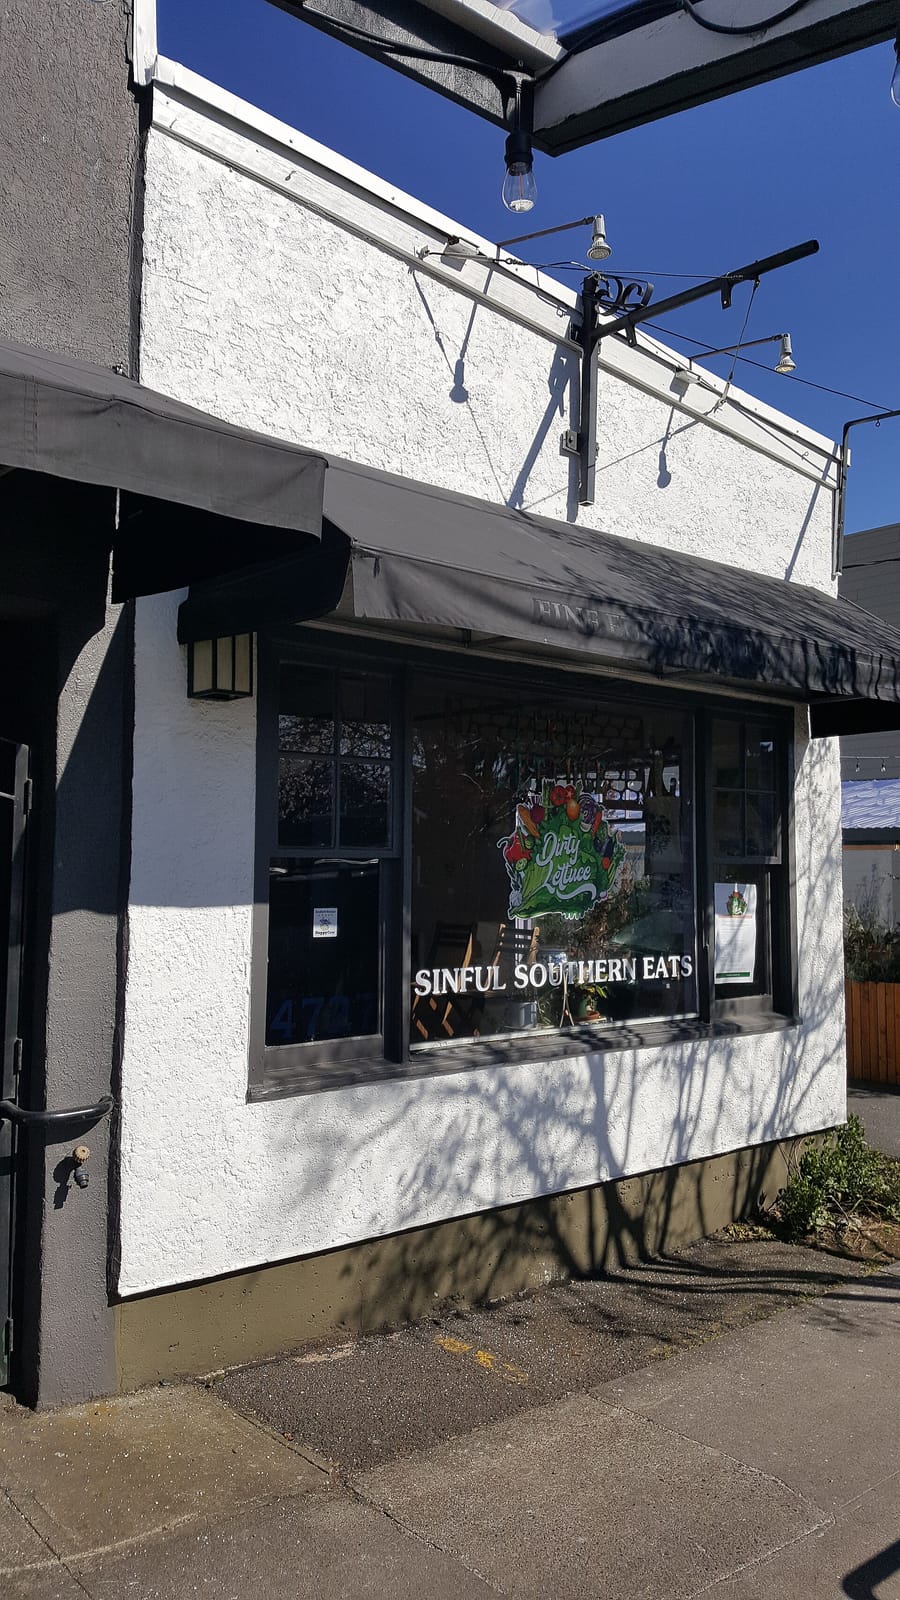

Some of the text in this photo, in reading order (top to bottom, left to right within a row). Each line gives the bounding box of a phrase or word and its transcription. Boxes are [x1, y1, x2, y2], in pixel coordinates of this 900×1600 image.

[536, 832, 580, 865] Dirty
[541, 860, 593, 894] Lettuce
[414, 955, 692, 996] SINFUL SOUTHERN EATS
